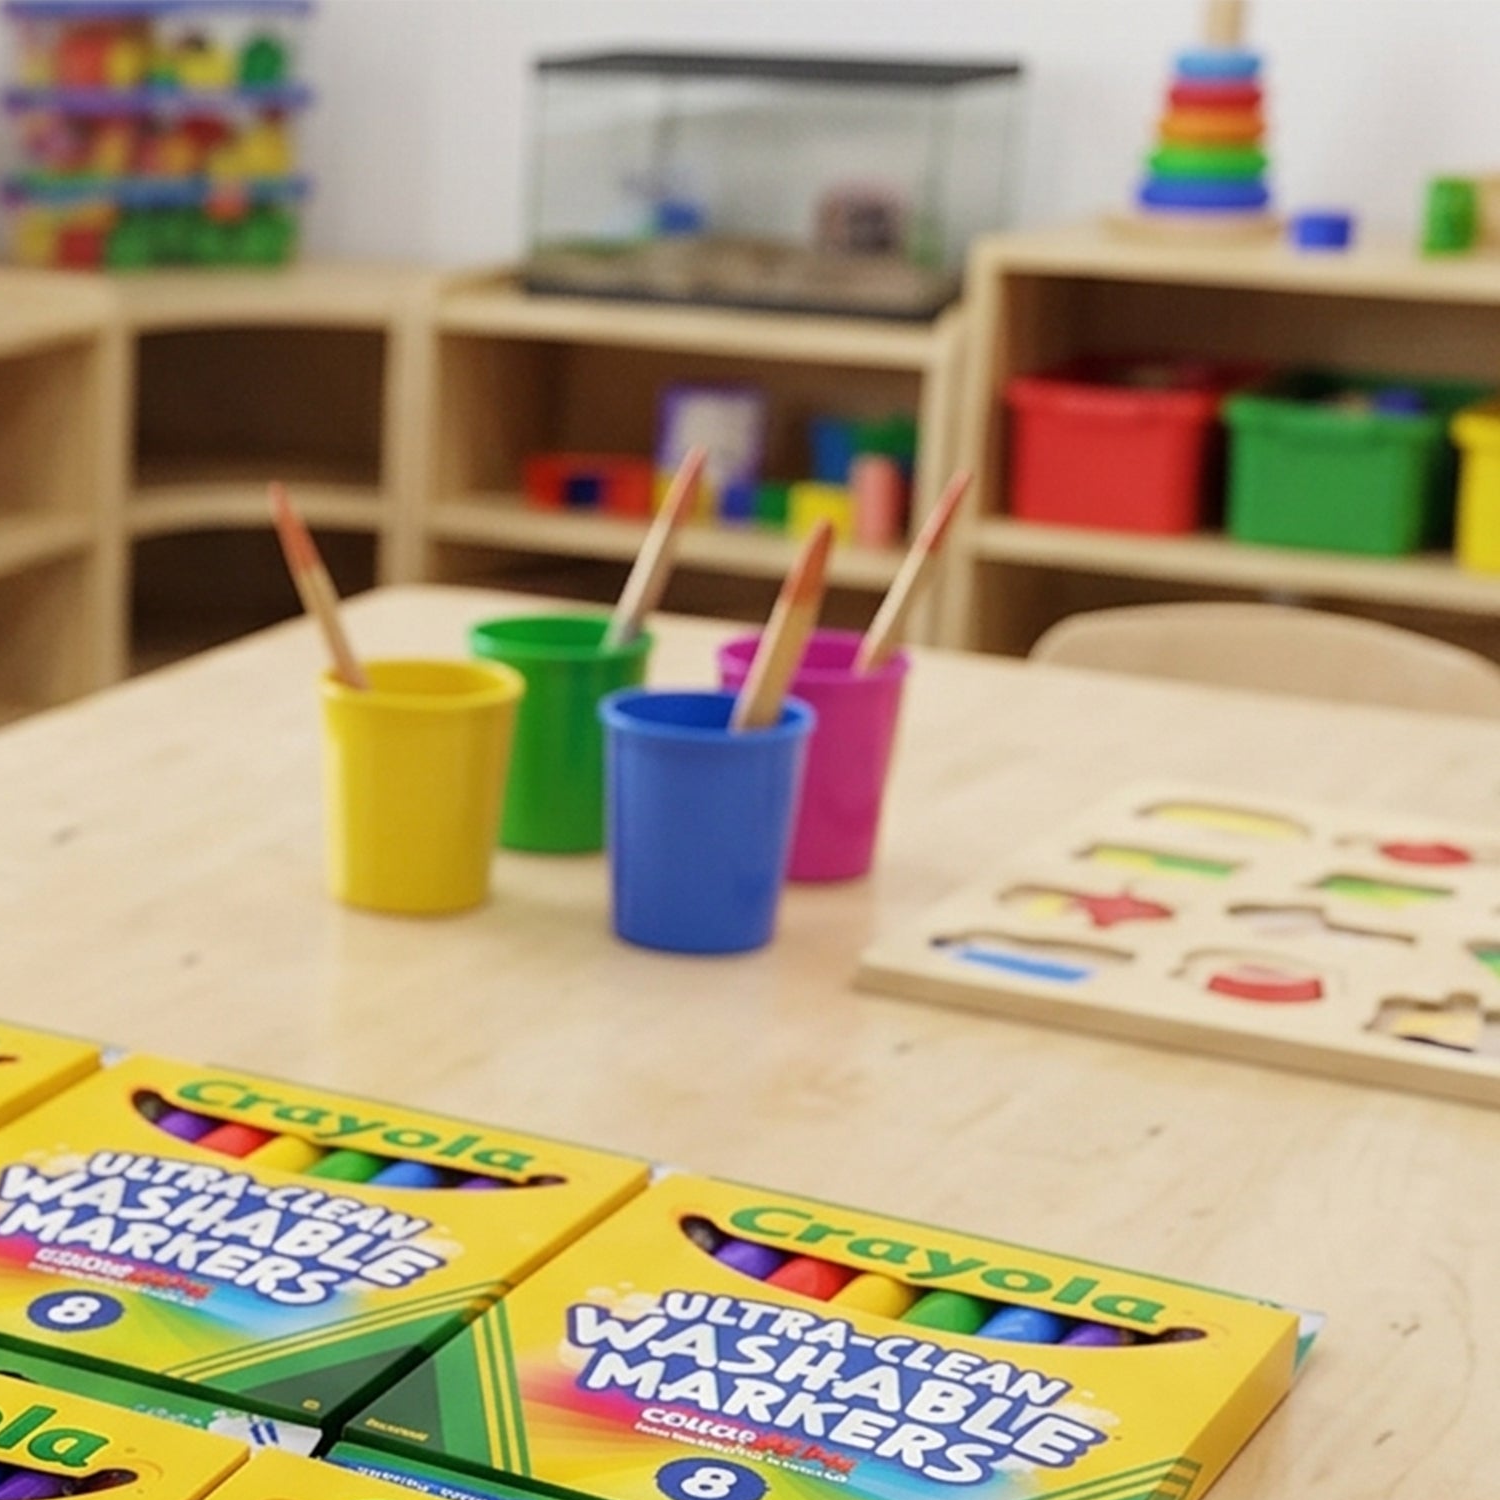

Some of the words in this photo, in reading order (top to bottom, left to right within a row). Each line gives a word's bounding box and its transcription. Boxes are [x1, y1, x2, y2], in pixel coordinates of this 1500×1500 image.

[176, 1080, 537, 1173] Crayola
[0, 1166, 441, 1285] WASHABLE
[91, 1153, 428, 1237] ULTRA-CLEAN
[47, 1296, 101, 1324] 8
[730, 1206, 1169, 1325] Crayola
[575, 1307, 1098, 1466] WASHABLE
[665, 1292, 1067, 1405] ULTRA-CLEAN
[586, 1355, 994, 1484] MARKERS
[680, 1465, 739, 1500] 8
